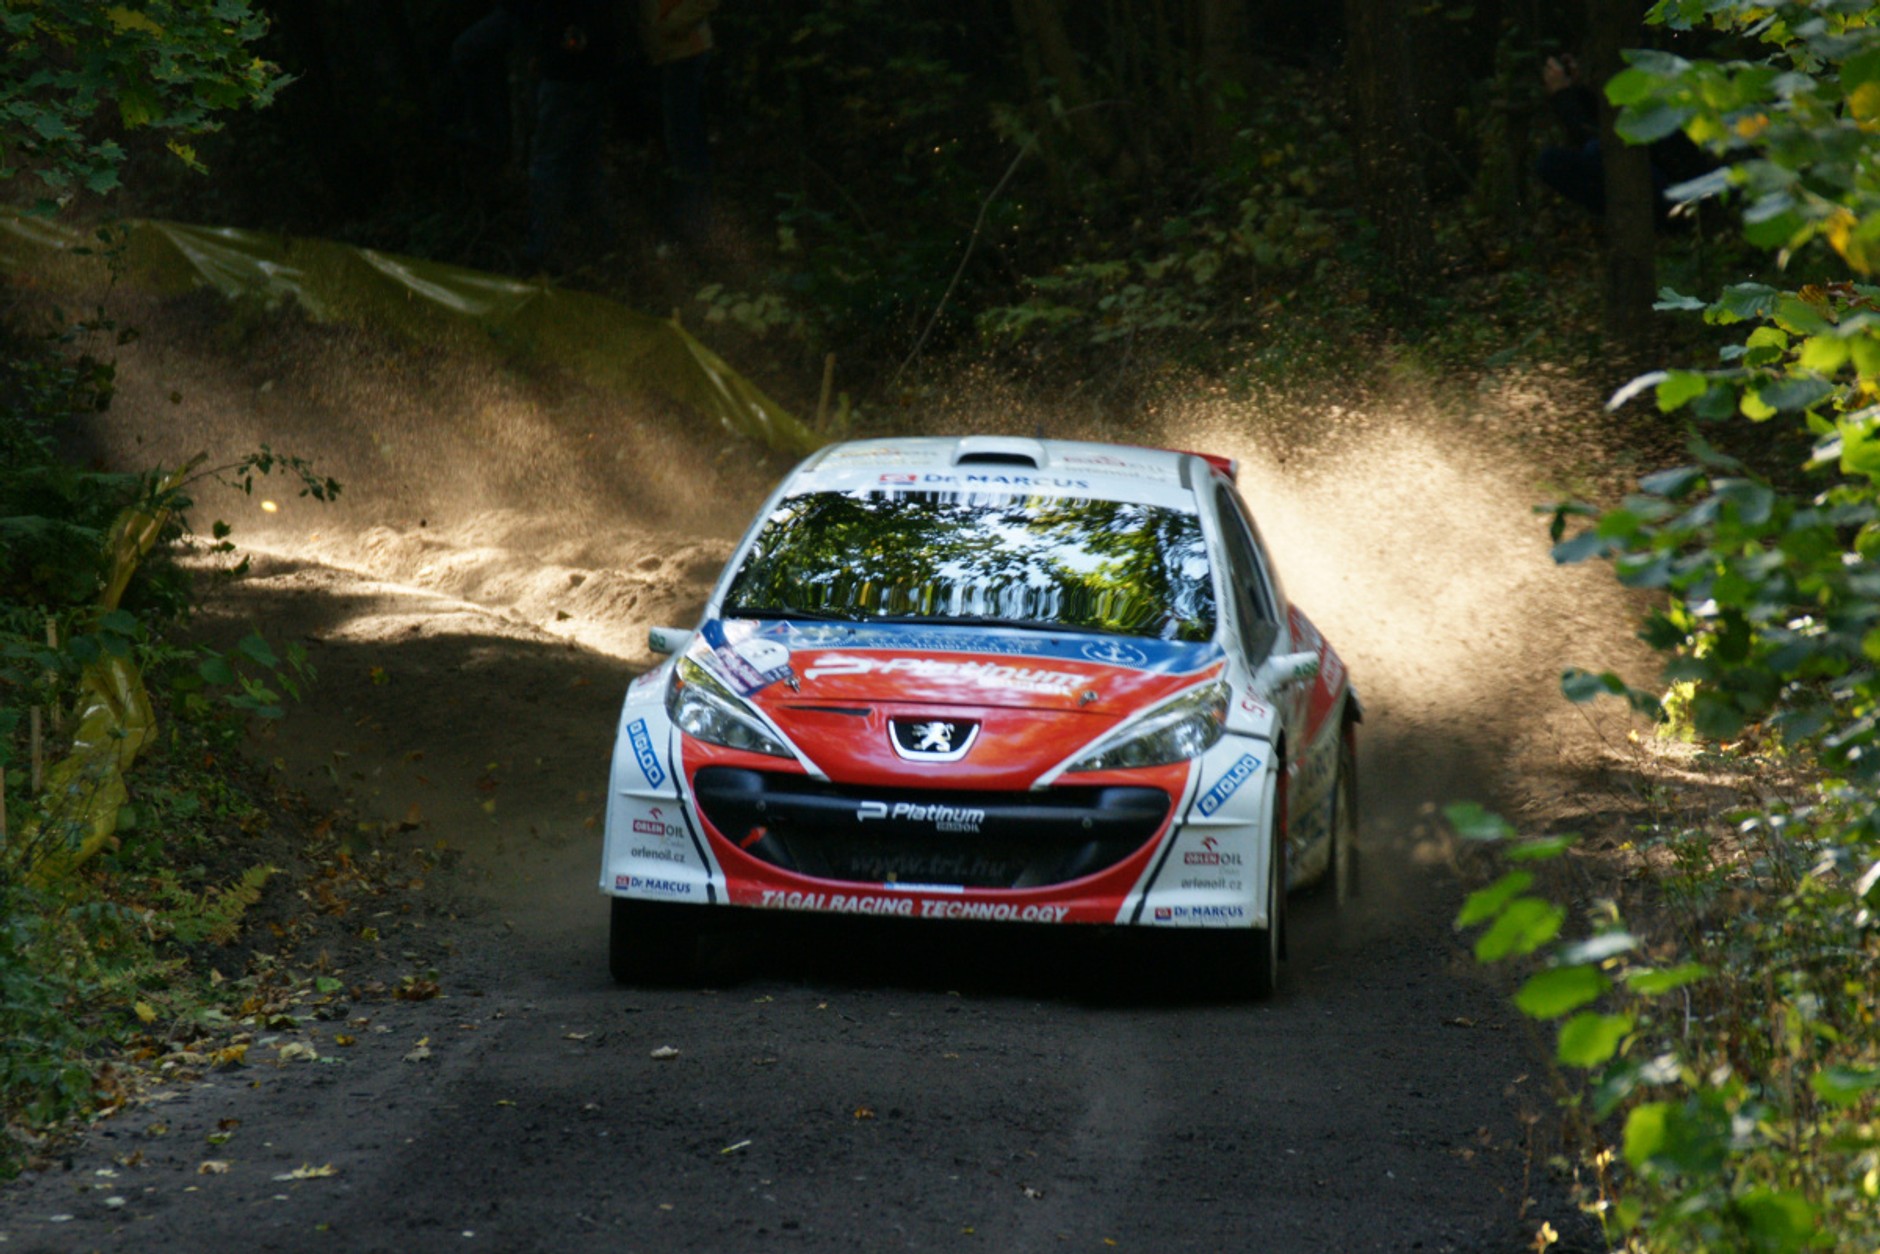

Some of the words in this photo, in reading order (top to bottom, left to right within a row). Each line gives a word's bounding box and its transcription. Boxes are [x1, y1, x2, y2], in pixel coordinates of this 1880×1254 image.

[966, 474, 1089, 488] MARCUS
[892, 802, 985, 824] Platinum
[666, 824, 685, 838] OIL
[1220, 853, 1243, 866] OIL
[645, 878, 691, 893] MARCUS
[761, 890, 824, 909] TAGAI
[828, 894, 913, 916] RACING
[919, 899, 1069, 923] TECHNOLOGY
[1191, 906, 1244, 917] MARCUS
